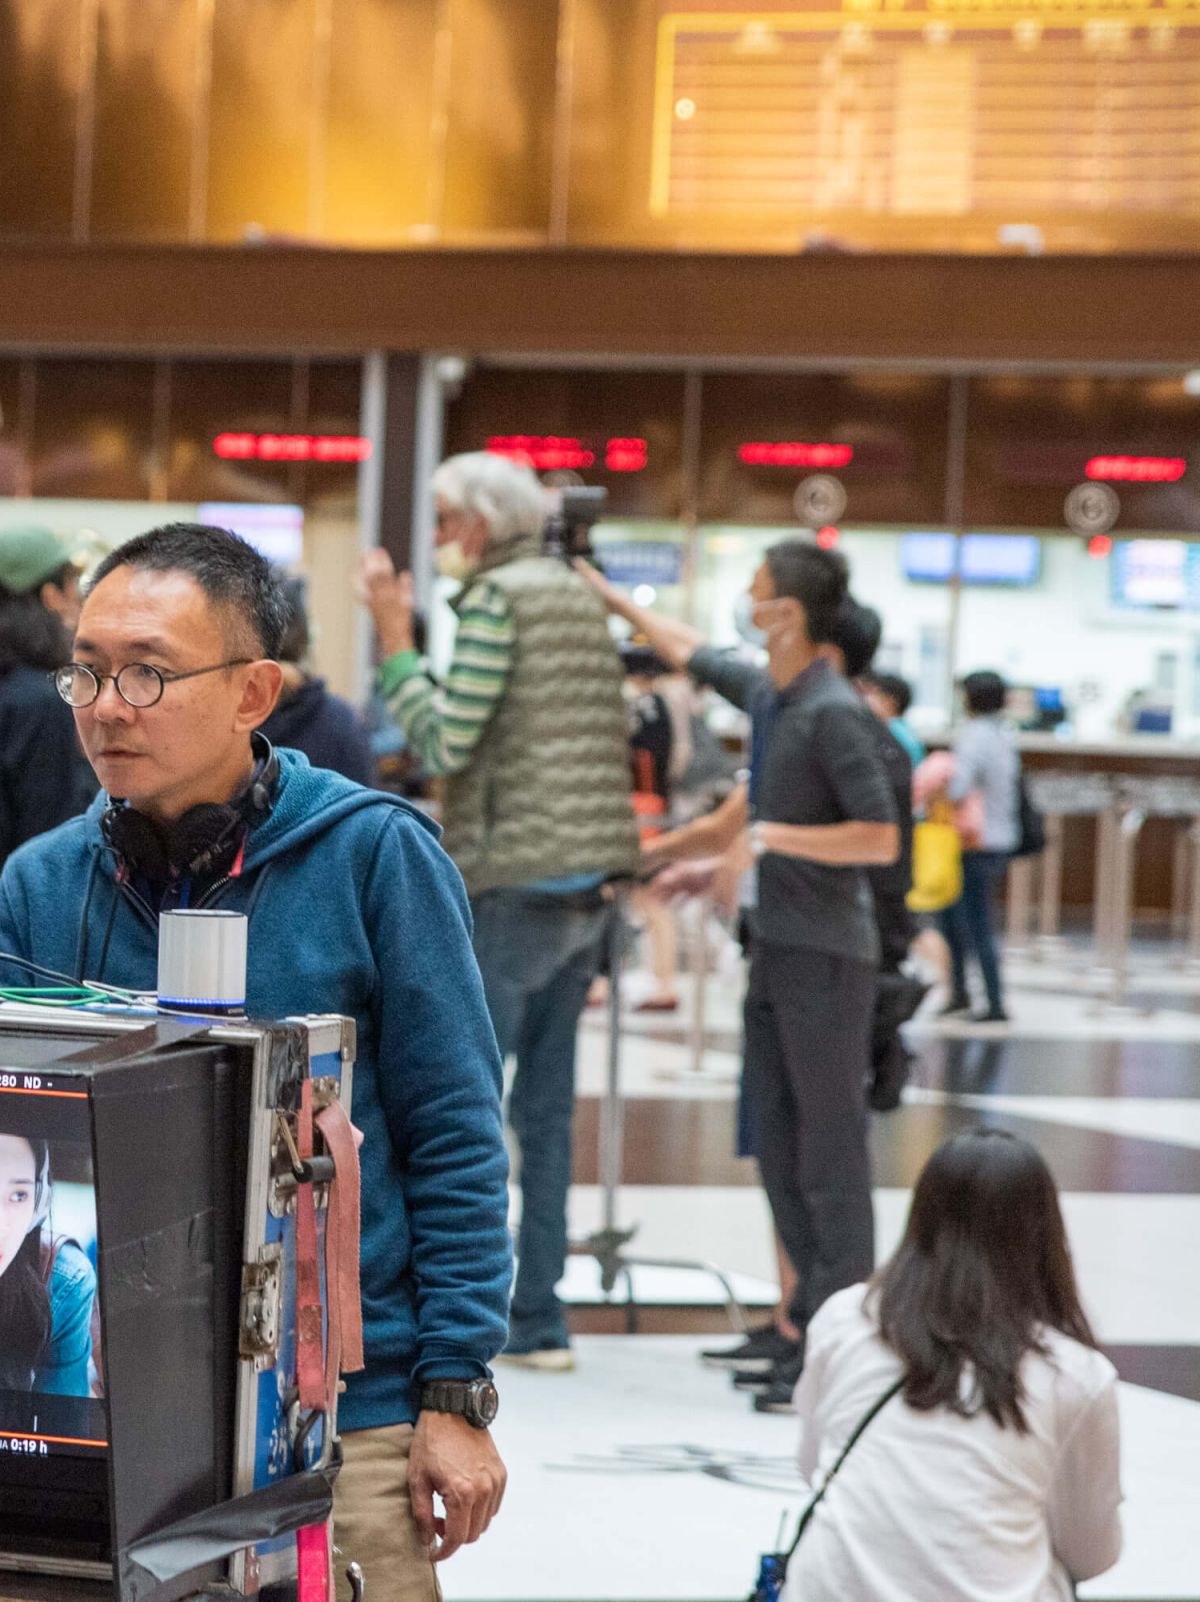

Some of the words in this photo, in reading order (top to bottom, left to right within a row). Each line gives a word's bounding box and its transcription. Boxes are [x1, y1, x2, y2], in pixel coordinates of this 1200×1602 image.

[23, 1076, 42, 1089] ND
[11, 1438, 37, 1452] 0:19
[39, 1440, 48, 1454] h
